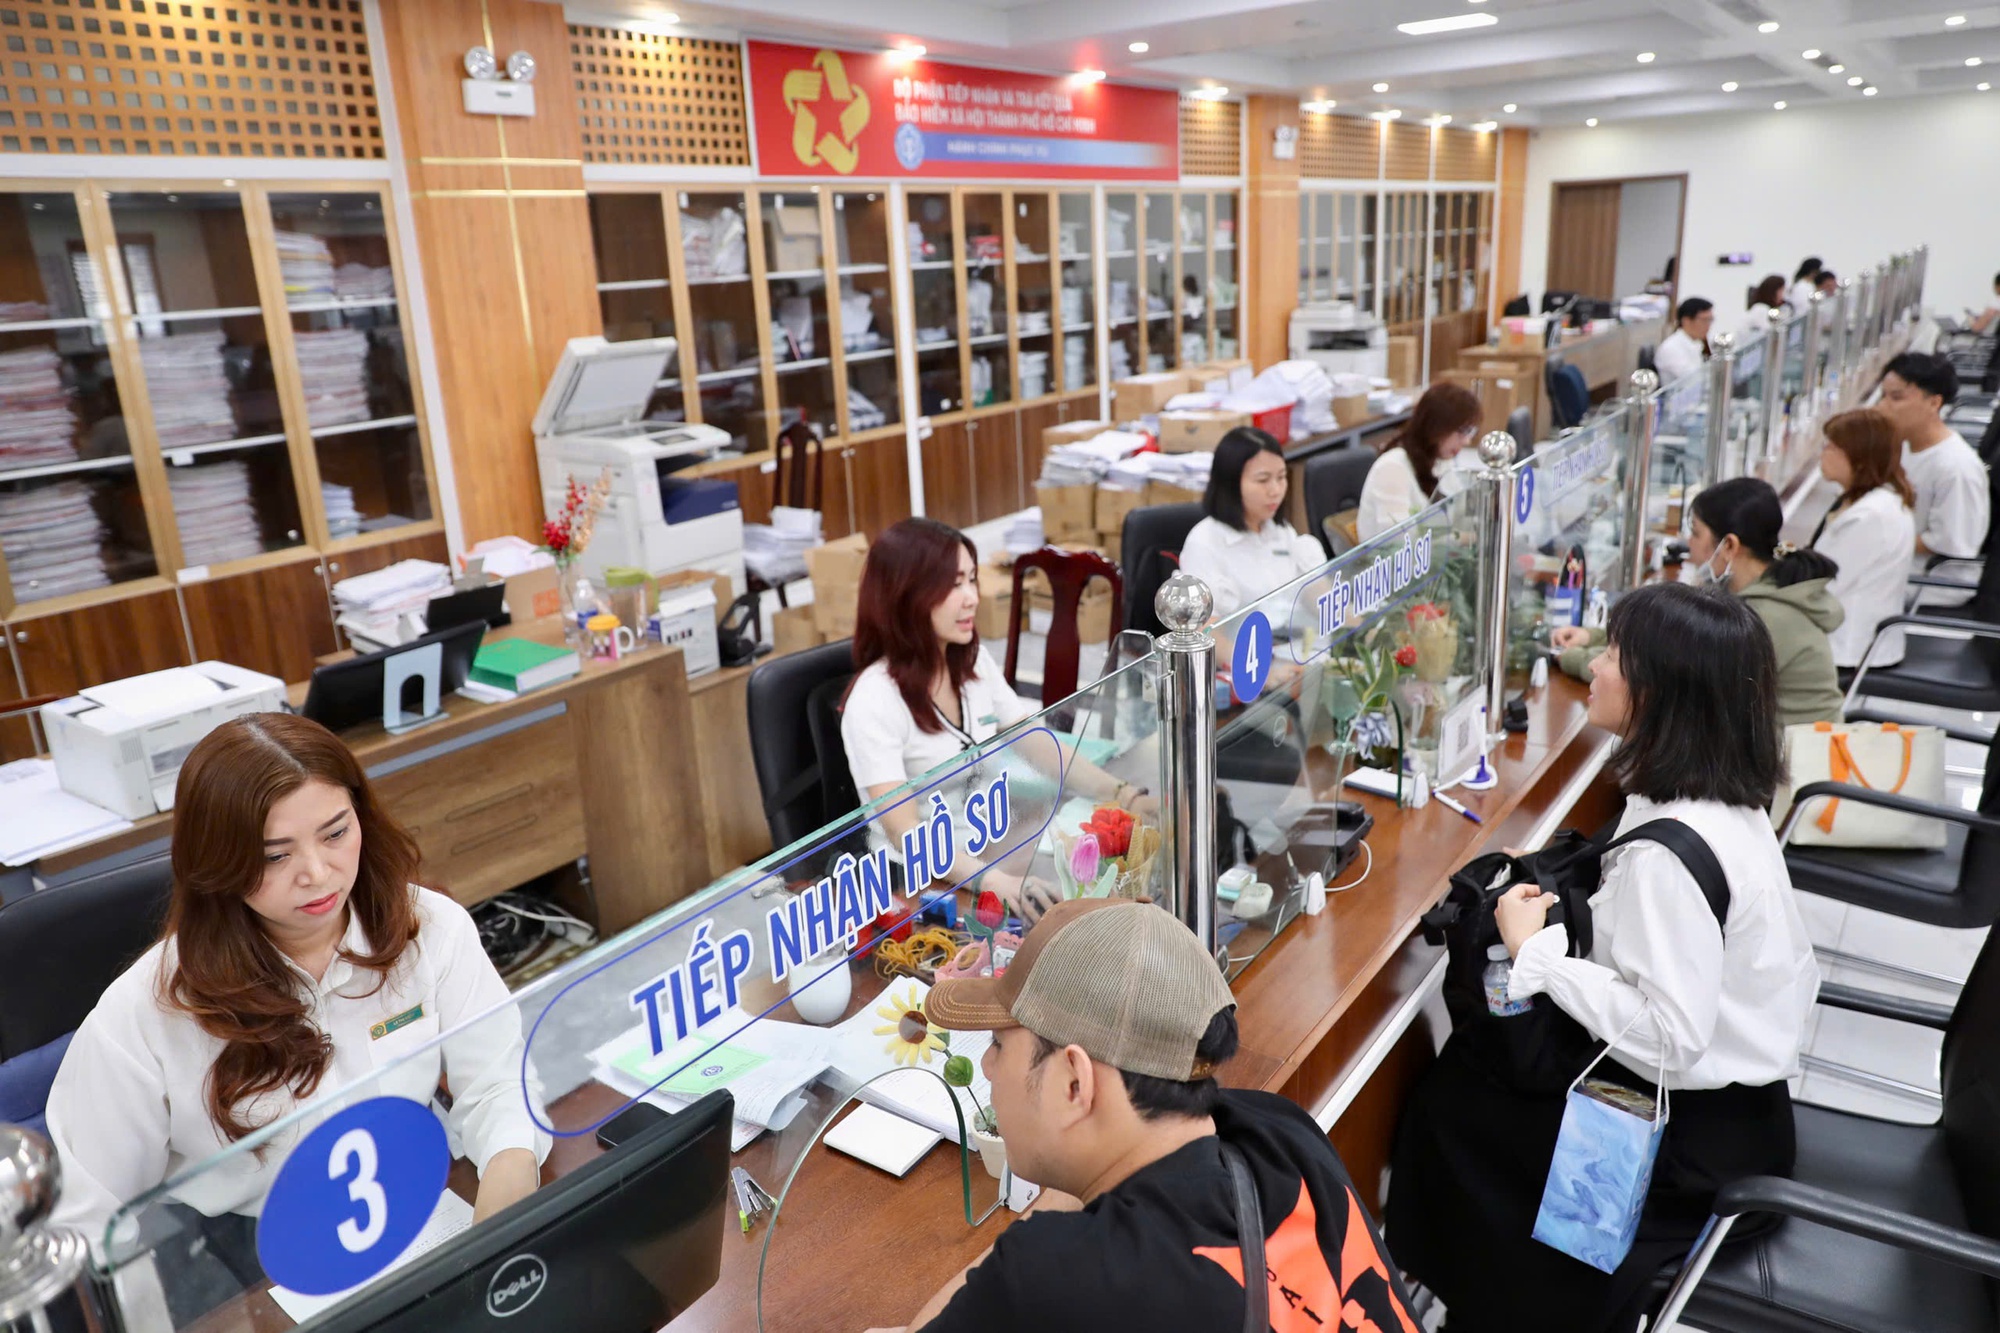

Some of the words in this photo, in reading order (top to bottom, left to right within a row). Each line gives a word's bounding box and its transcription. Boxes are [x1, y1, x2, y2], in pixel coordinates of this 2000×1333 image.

[1521, 472, 1529, 515] 5
[1317, 570, 1350, 637] TIẾP
[1353, 555, 1391, 617] NHẬN
[1394, 533, 1411, 592] HỒ
[1414, 529, 1432, 579] SƠ
[1246, 624, 1259, 684] 4
[631, 919, 753, 1058] TIẾP
[767, 849, 892, 983] NHẬN
[902, 790, 955, 898] HỒ
[965, 769, 1012, 857] SƠ
[328, 1128, 387, 1253] 3
[493, 1269, 541, 1306] DELL
